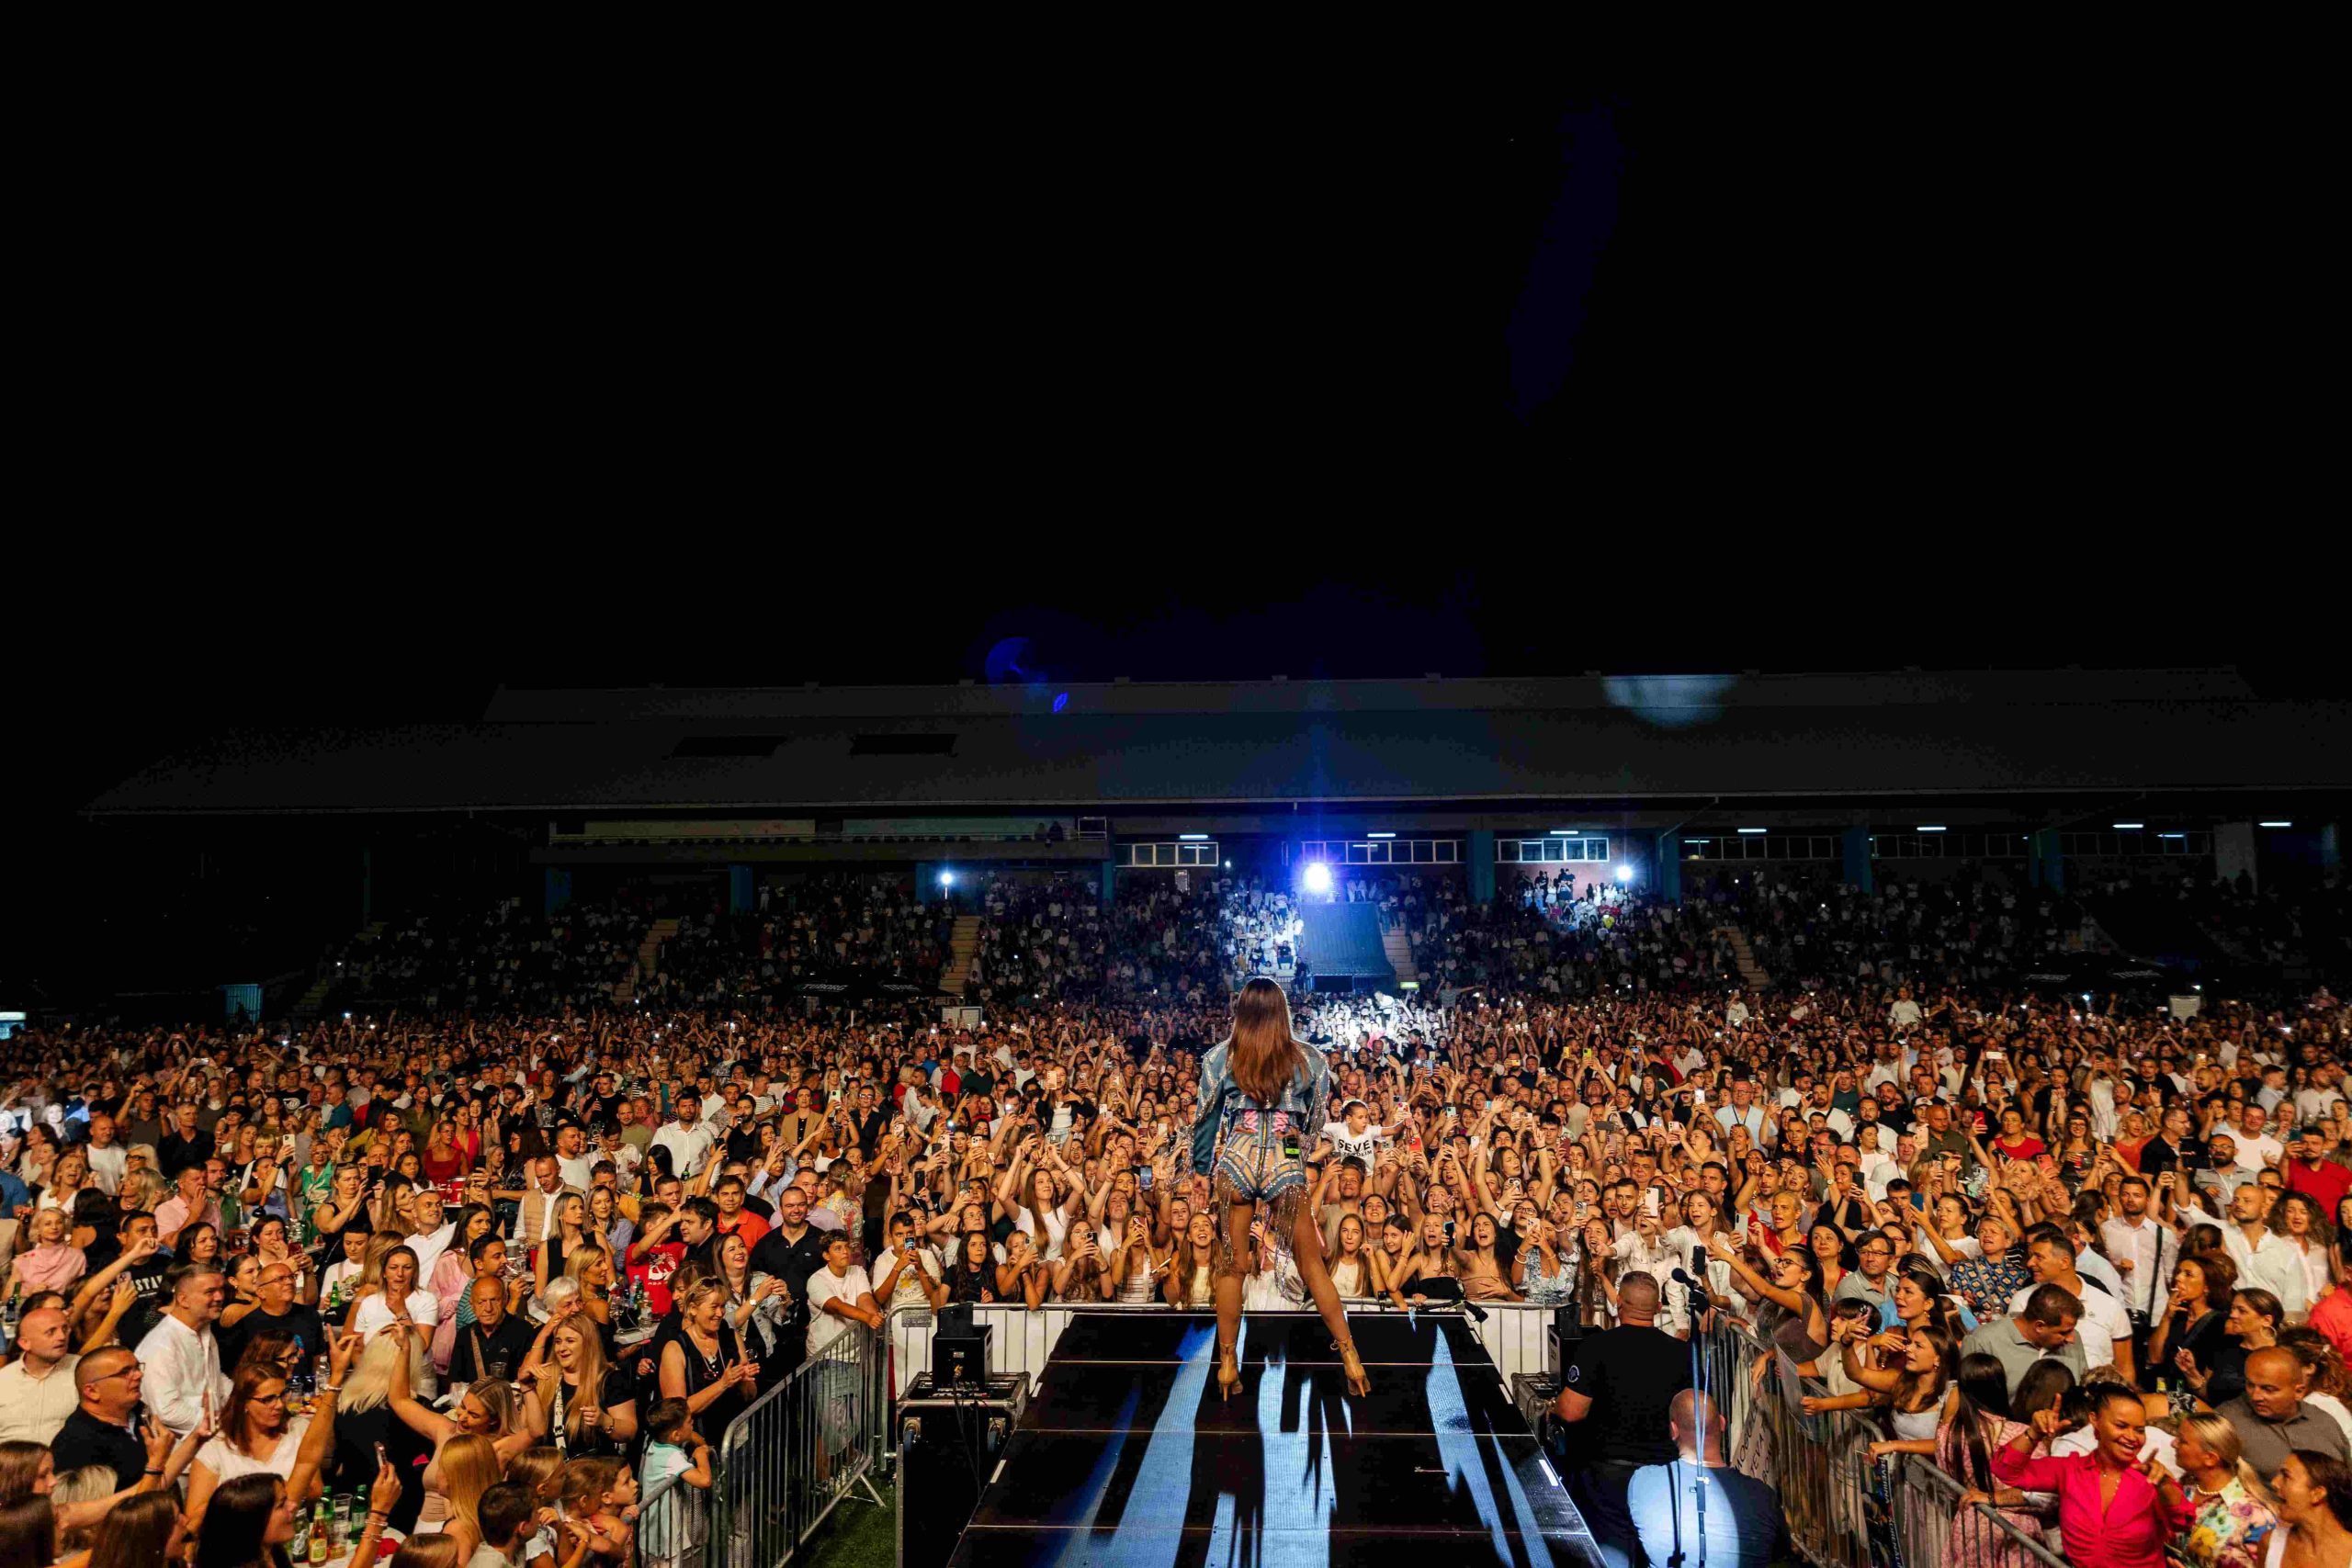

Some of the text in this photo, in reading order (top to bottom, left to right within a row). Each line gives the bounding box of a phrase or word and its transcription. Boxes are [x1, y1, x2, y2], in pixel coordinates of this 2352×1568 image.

[803, 984, 849, 992] TUBORG
[1338, 1139, 1371, 1153] SEVE
[1888, 1516, 1903, 1568] ADRENALI
